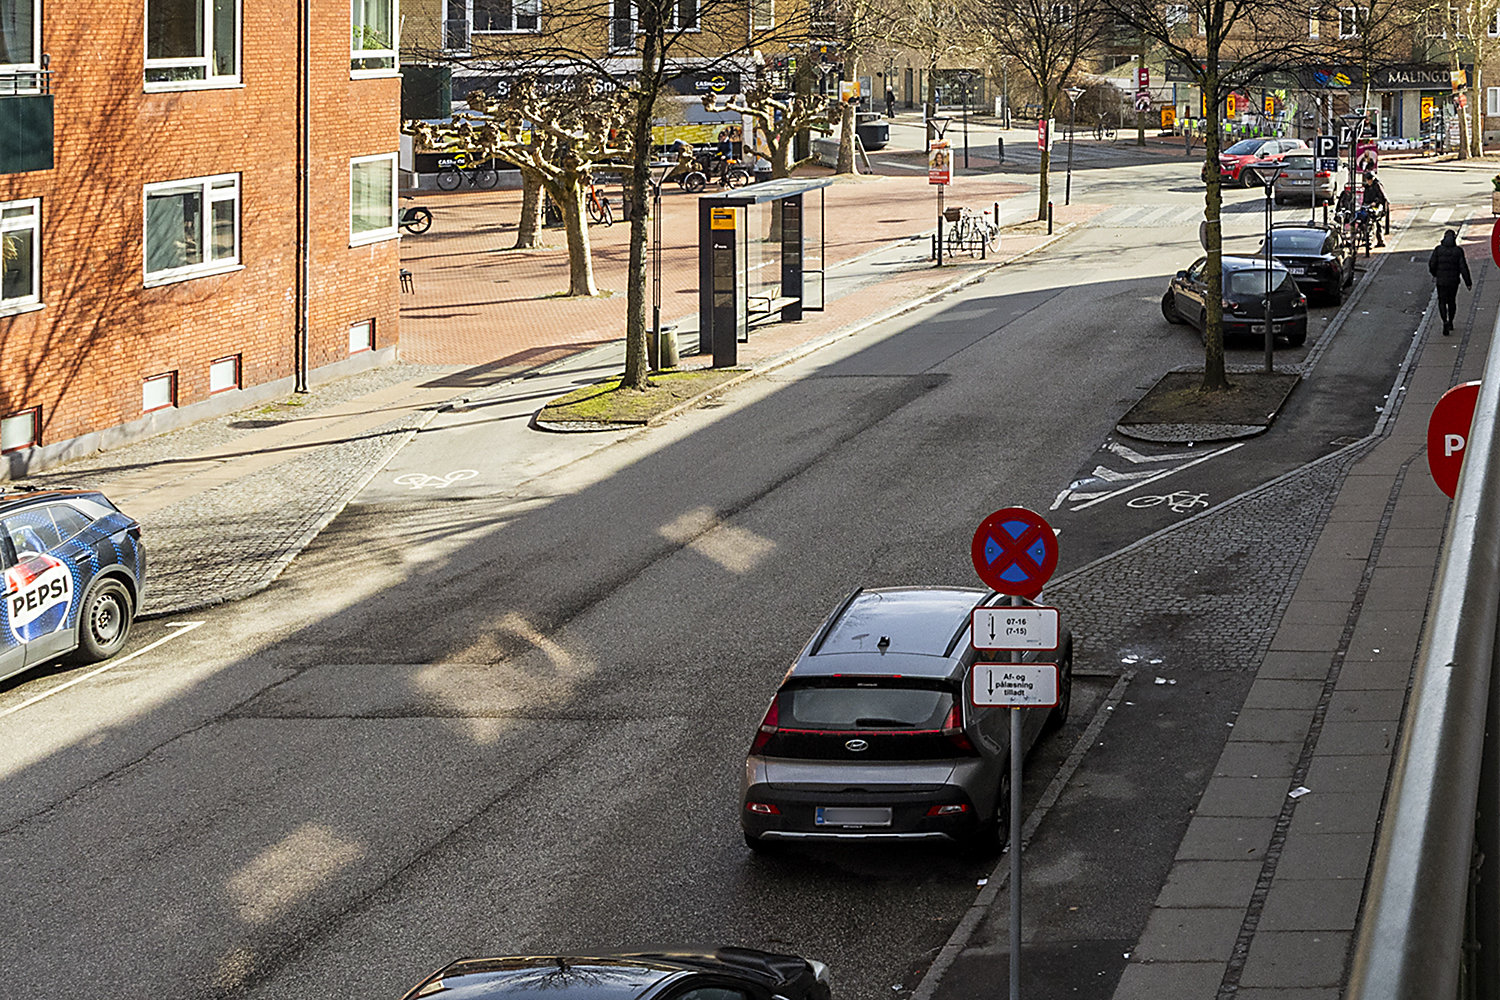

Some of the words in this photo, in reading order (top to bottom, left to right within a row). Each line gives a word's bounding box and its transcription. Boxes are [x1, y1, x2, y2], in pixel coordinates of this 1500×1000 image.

[1388, 71, 1450, 83] MALING.D
[1321, 138, 1334, 156] P
[12, 575, 69, 618] PEPSI
[1006, 618, 1027, 626] 07-16
[1005, 628, 1027, 636] (7-15)
[995, 681, 1034, 690] pålæsning
